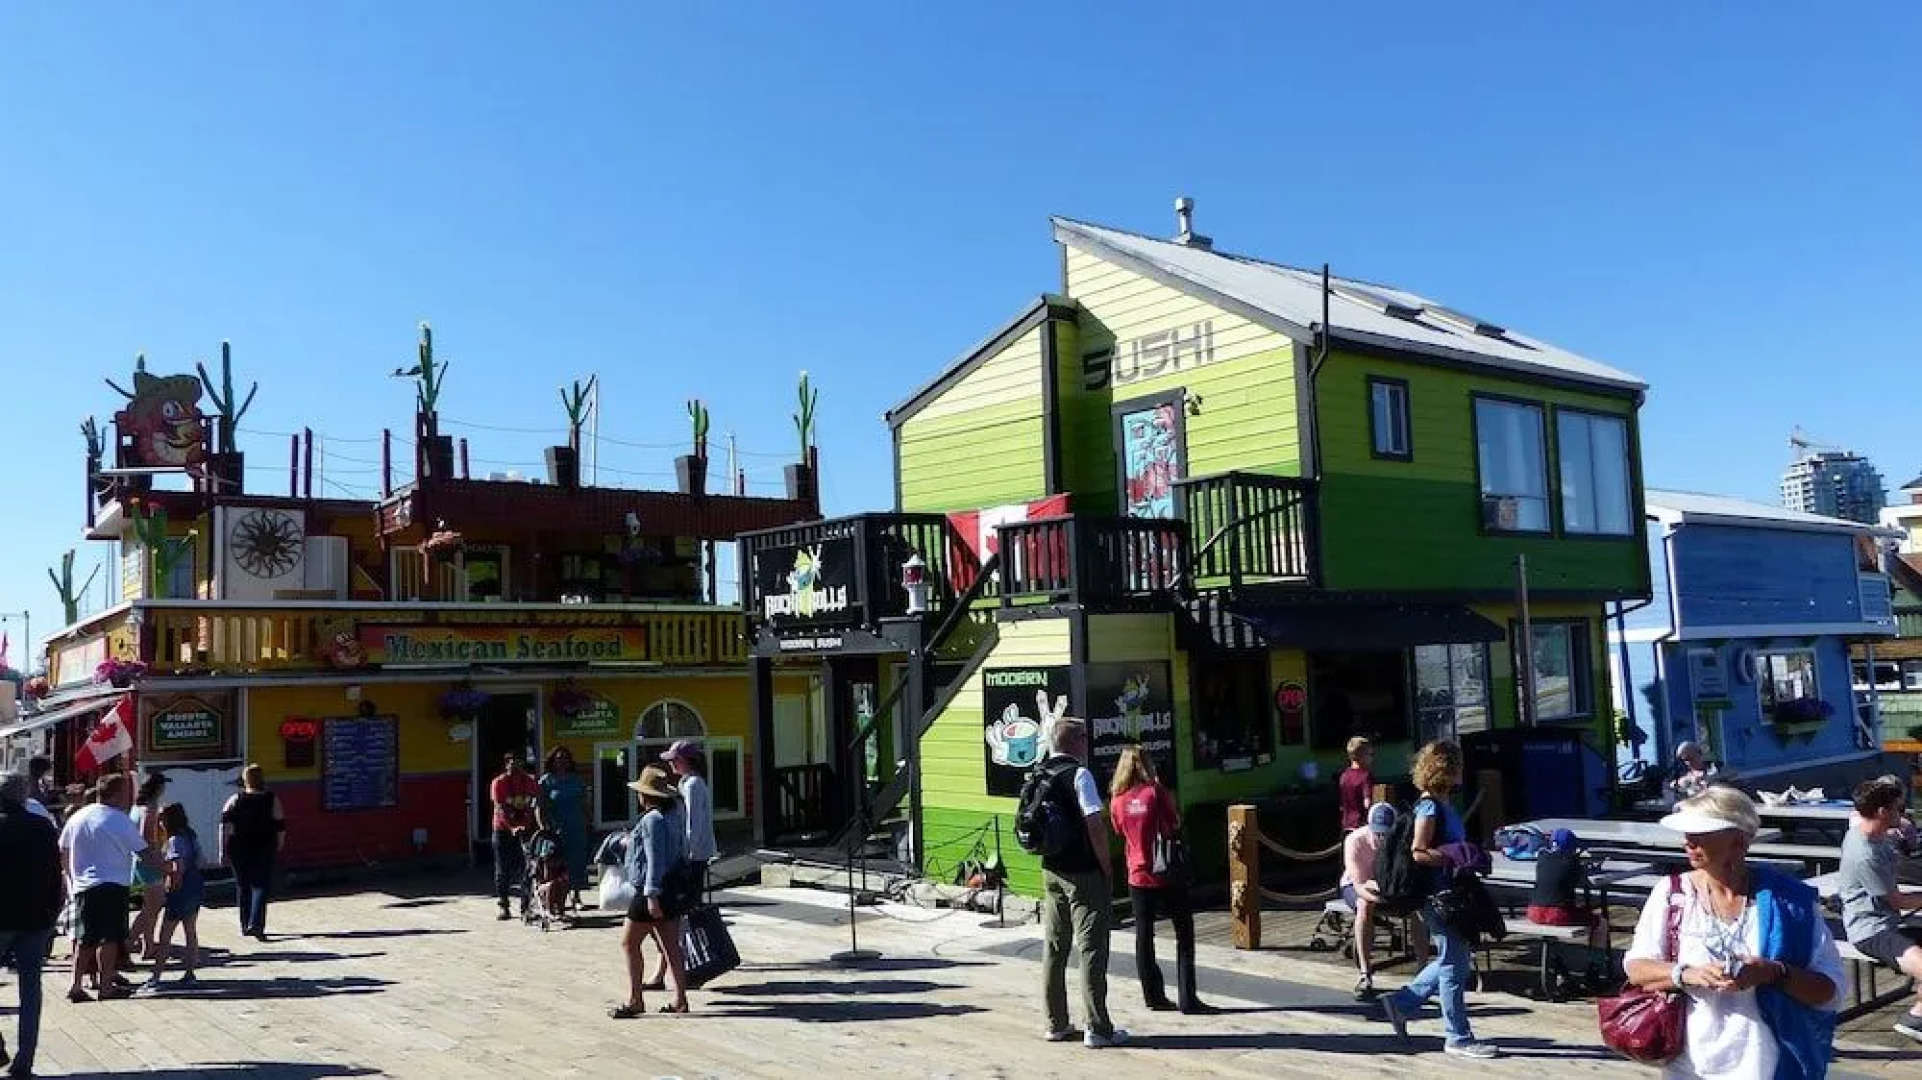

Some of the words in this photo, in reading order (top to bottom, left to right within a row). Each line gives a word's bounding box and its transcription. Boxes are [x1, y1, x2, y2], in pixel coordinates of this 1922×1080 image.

[1083, 320, 1214, 391] SUSHI
[384, 634, 508, 661] Mexican
[517, 633, 623, 661] Seafood
[985, 671, 1049, 687] MODERN
[281, 720, 317, 739] OPEN
